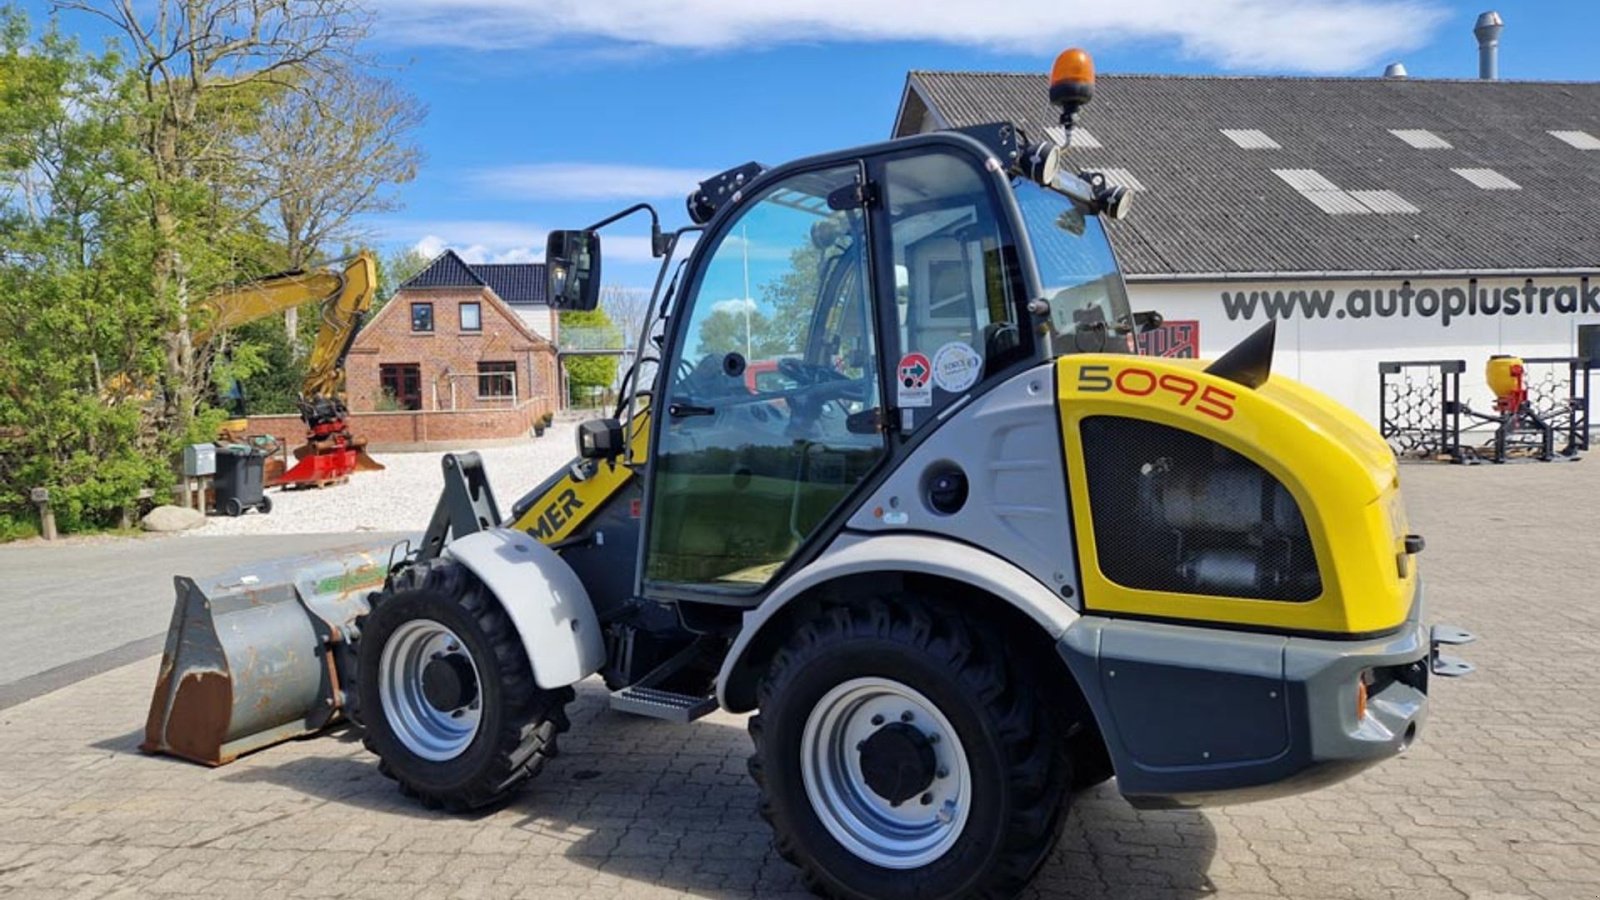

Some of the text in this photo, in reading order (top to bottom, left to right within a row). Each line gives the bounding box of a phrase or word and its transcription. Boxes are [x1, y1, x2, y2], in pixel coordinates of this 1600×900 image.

[1221, 278, 1600, 327] www.autoplustrak
[1078, 366, 1237, 421] 5095
[526, 488, 585, 539] MER
